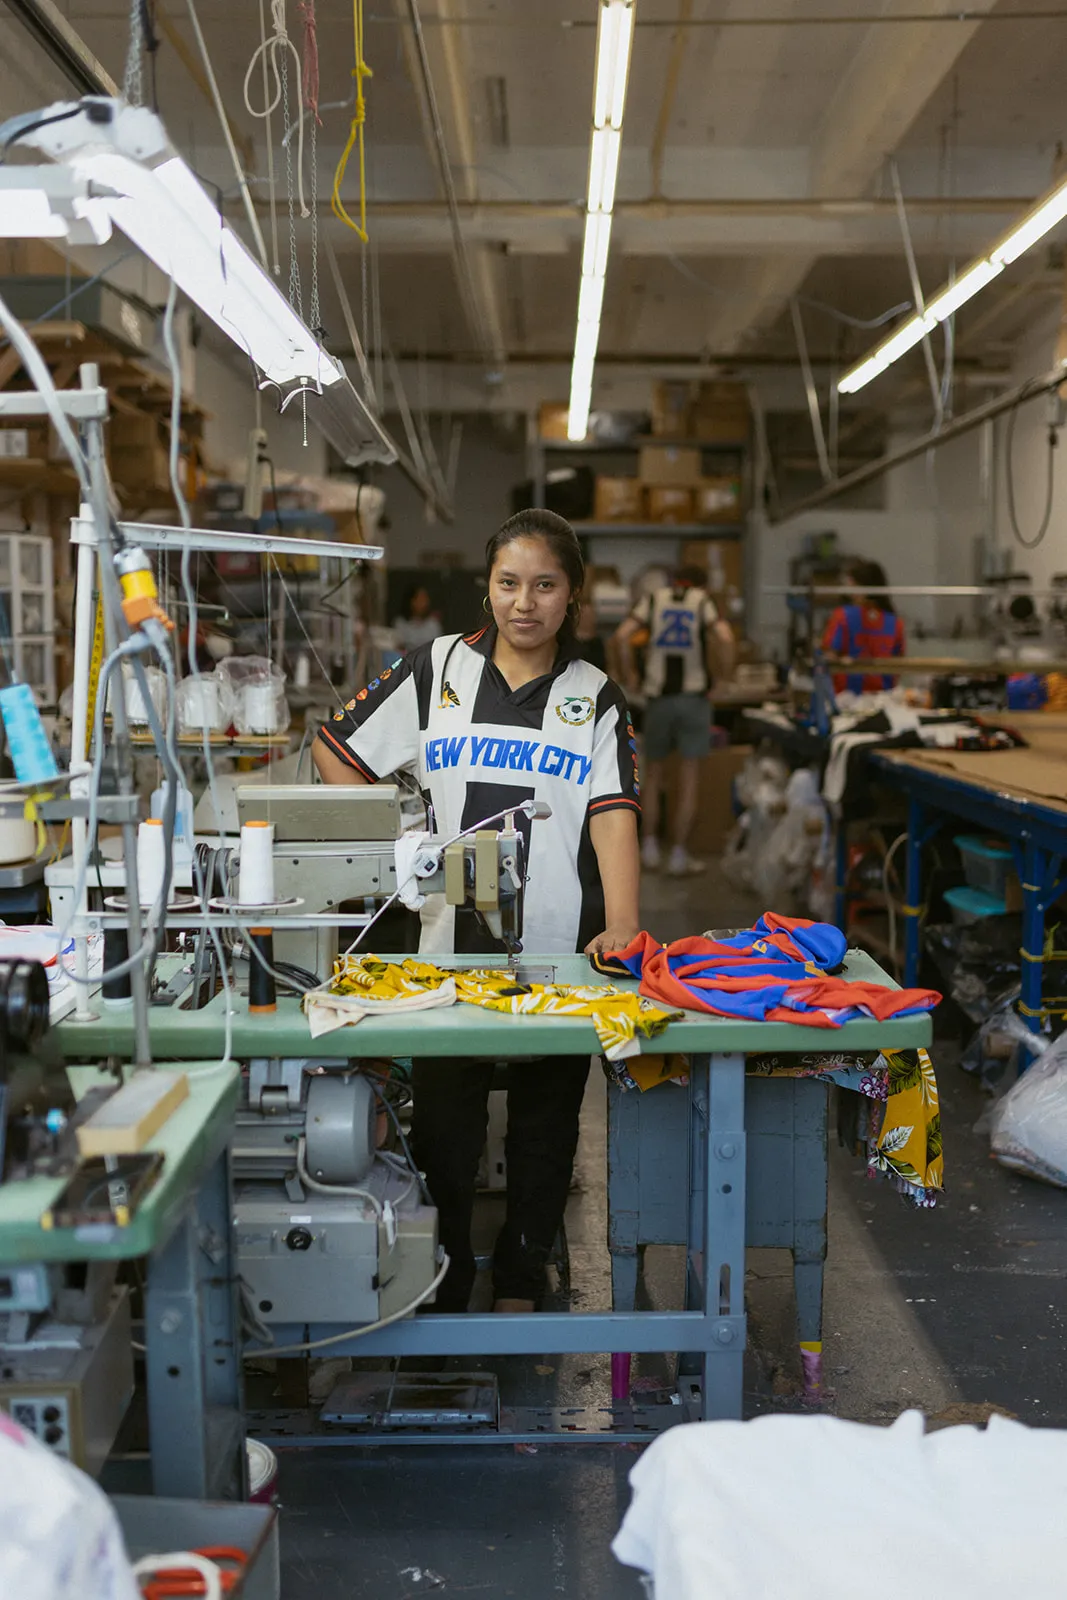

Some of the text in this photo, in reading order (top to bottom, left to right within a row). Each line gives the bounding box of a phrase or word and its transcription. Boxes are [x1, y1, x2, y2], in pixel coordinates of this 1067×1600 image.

[425, 736, 592, 786] NEW YORK CITY
